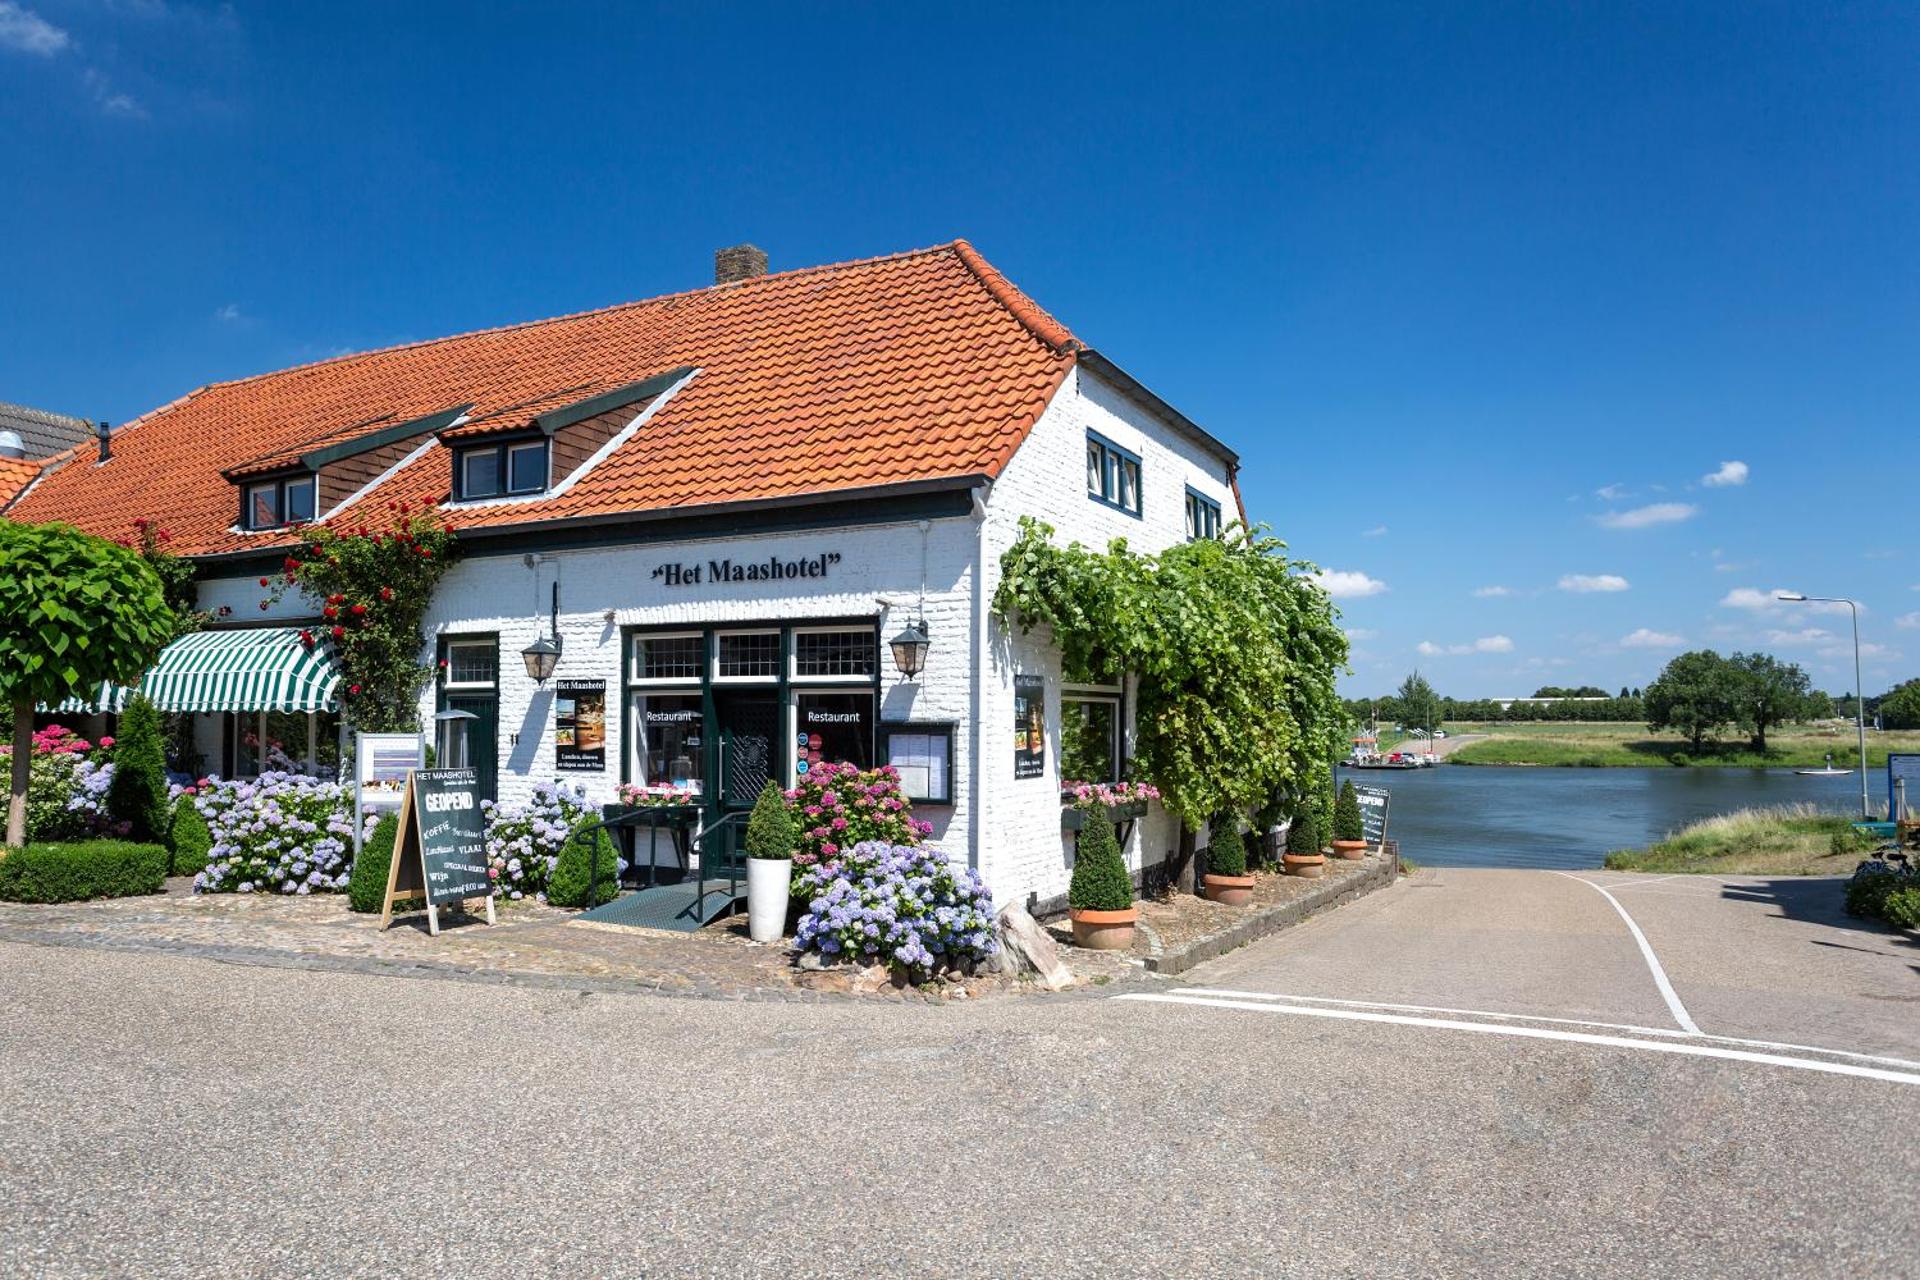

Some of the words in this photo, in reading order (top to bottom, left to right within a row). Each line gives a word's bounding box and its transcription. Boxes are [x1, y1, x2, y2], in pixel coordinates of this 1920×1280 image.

[557, 681, 570, 690] Het
[571, 681, 605, 690] Maashotel
[646, 711, 692, 722] Restaurant
[808, 711, 860, 723] Restaurant
[416, 772, 431, 780] HET
[425, 791, 473, 812] GEOPEND
[423, 820, 451, 840] KOFFIE
